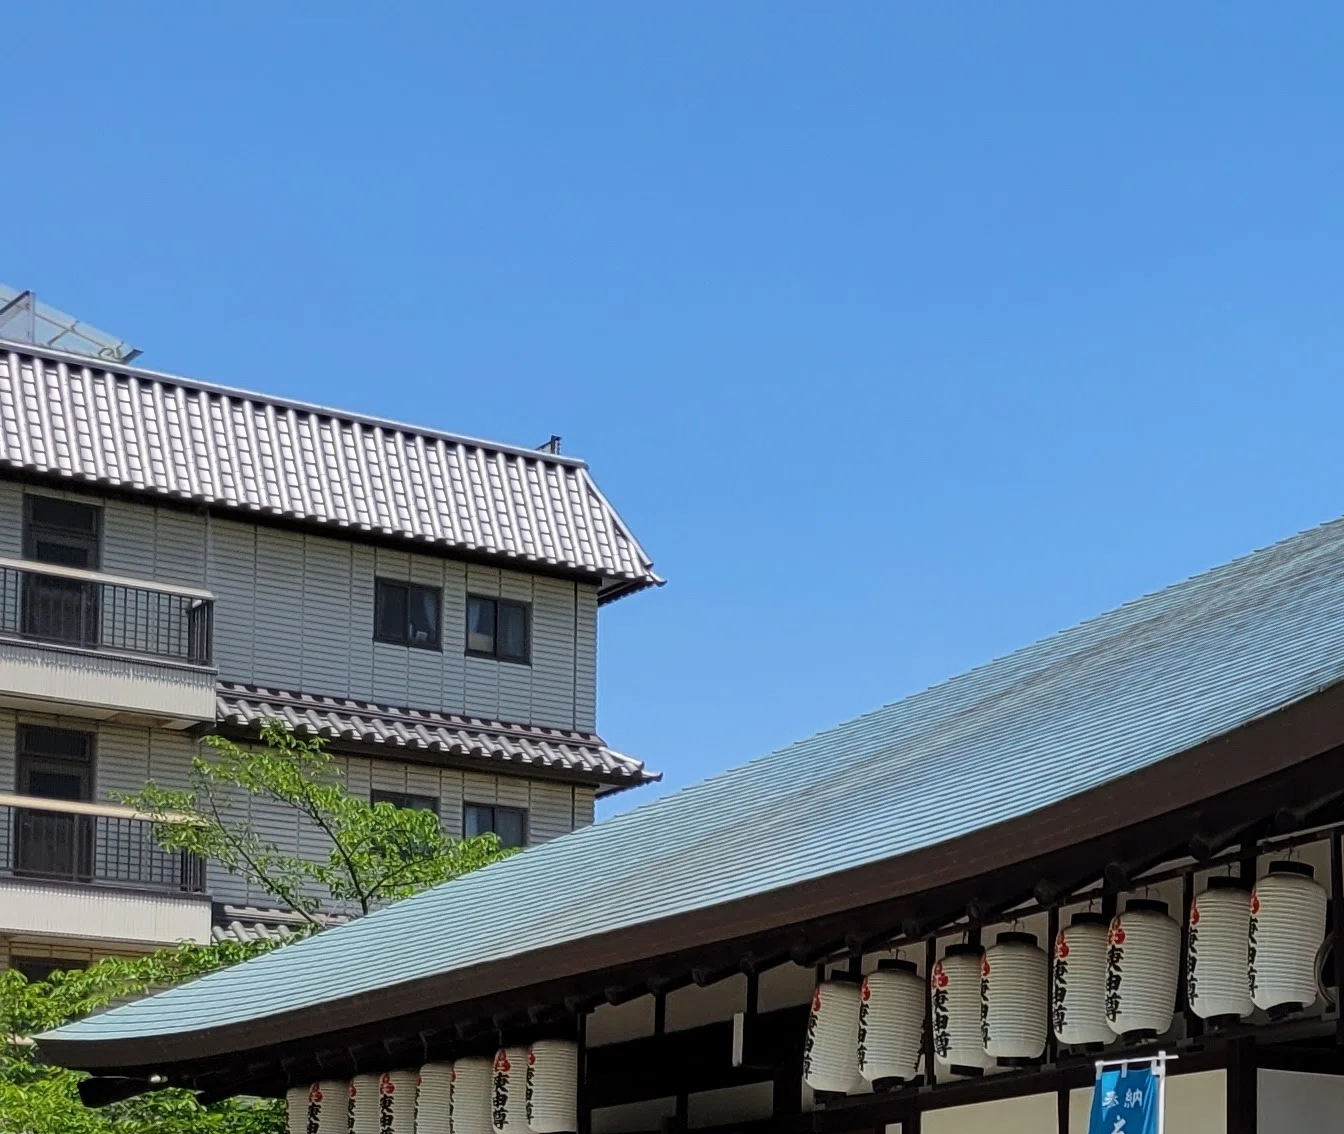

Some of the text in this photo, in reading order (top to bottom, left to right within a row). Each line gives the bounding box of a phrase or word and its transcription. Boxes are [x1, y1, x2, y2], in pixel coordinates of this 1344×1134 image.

[1105, 945, 1125, 1022] 庚申尊
[933, 988, 953, 1057] 庚申尊
[492, 1072, 510, 1130] 庚申尊
[1102, 1089, 1143, 1108] 奉納
